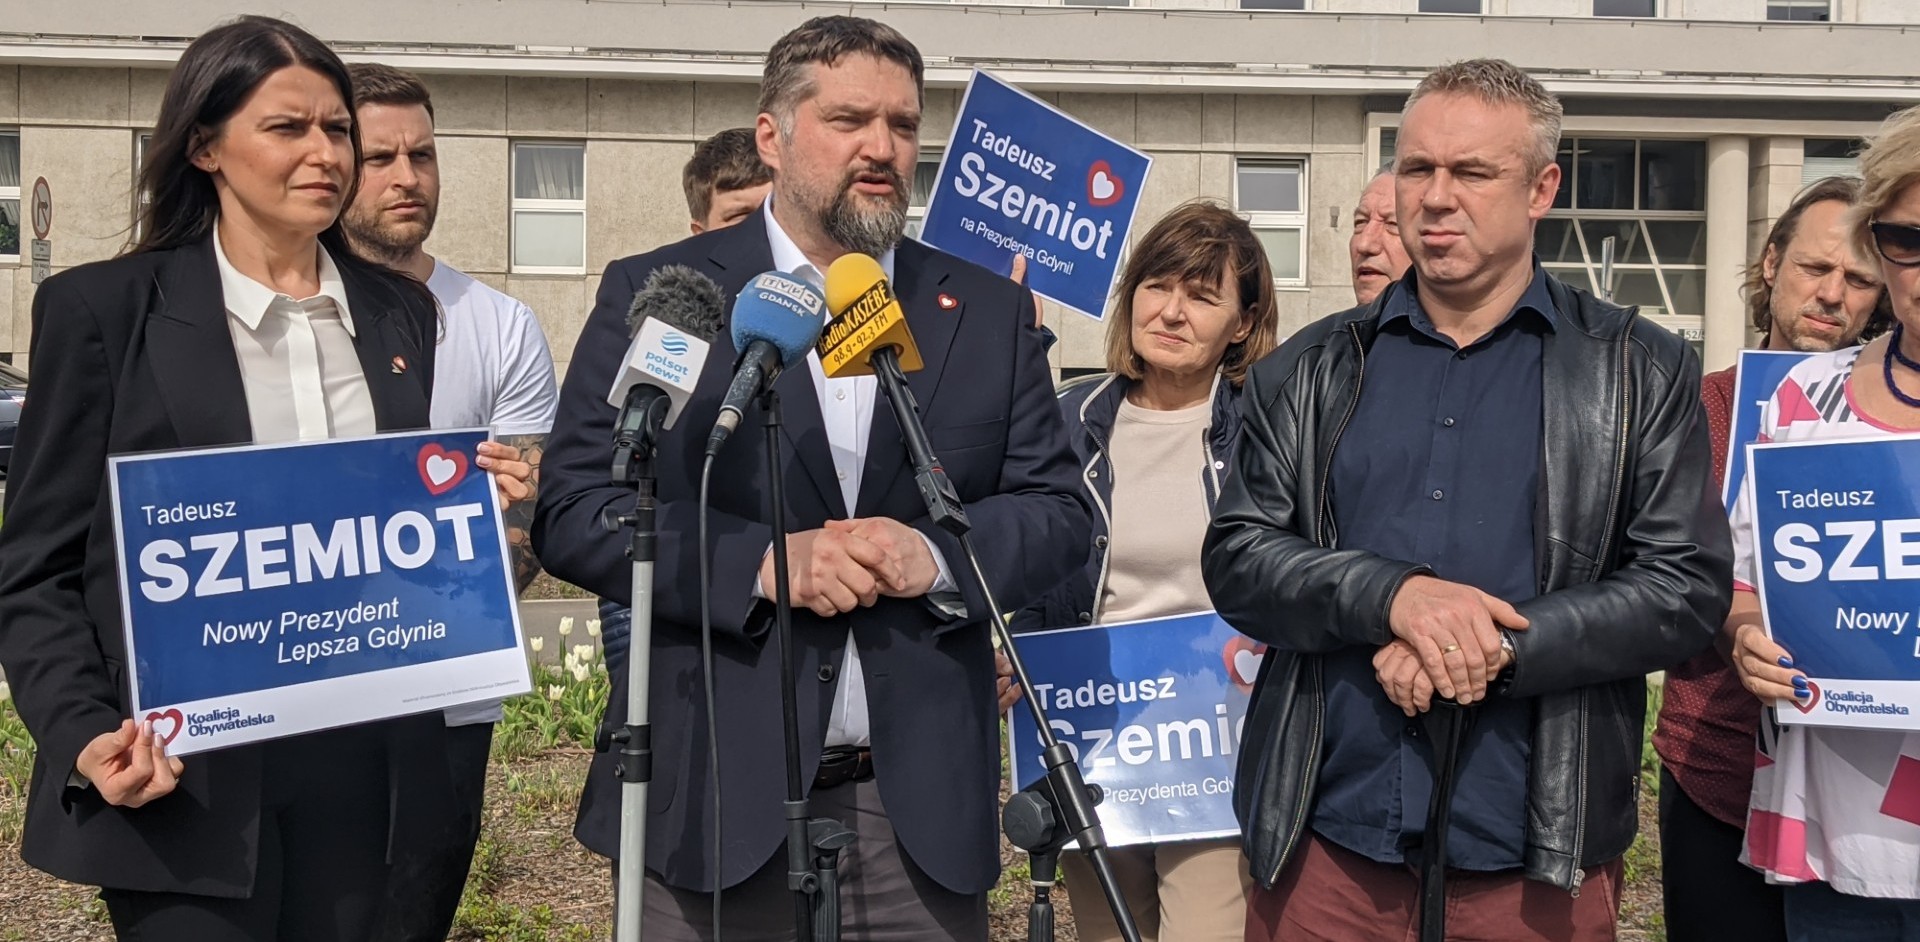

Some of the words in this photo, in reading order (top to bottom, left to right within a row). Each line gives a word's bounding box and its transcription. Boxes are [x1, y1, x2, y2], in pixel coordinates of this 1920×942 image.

[971, 117, 1057, 181] Tadeusz
[954, 151, 1113, 260] Szemiot
[960, 216, 974, 232] na
[976, 221, 1034, 260] Prezydenta
[1036, 249, 1075, 276] Gdyni!
[873, 311, 889, 331] FM
[1685, 330, 1705, 340] 52/
[645, 351, 689, 376] polsat
[646, 362, 681, 384] news
[1775, 488, 1875, 509] Tadeusz
[141, 501, 237, 526] Tadeusz
[138, 502, 484, 603] SZEMIOT
[202, 619, 273, 647] Nowy
[280, 596, 400, 635] Prezydent
[1835, 606, 1910, 635] Nowy
[277, 635, 360, 665] Lepsza
[368, 619, 447, 650] Gdynia
[1034, 676, 1177, 711] Tadeusz
[1824, 689, 1874, 705] Koalicja
[187, 707, 240, 726] Koalicja
[1825, 701, 1909, 715] Obywatelska
[188, 713, 275, 737] Obywatelska
[1036, 703, 1247, 772] Szemi
